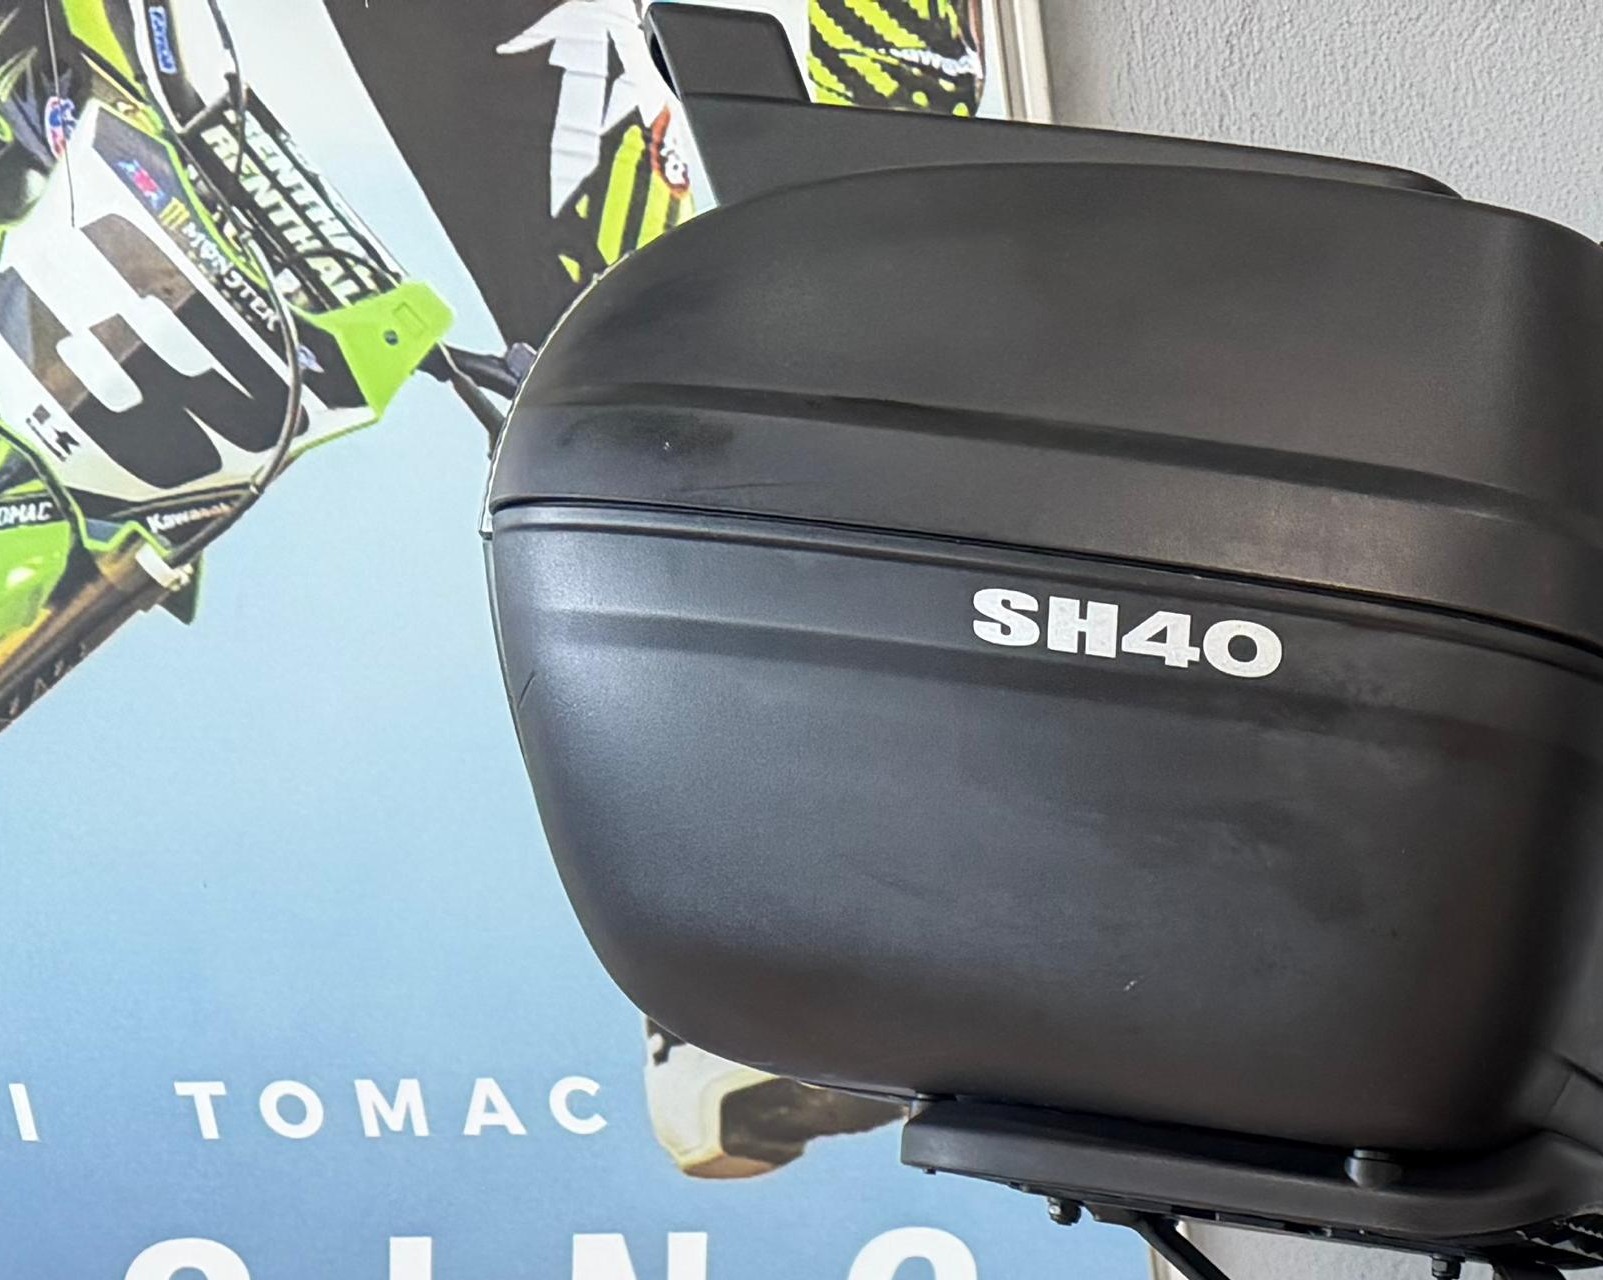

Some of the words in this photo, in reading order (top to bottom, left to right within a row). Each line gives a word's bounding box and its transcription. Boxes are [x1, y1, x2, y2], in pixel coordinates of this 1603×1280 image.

[973, 588, 1283, 678] SH40
[8, 1083, 38, 1141] I
[174, 1076, 608, 1140] TOMAC
